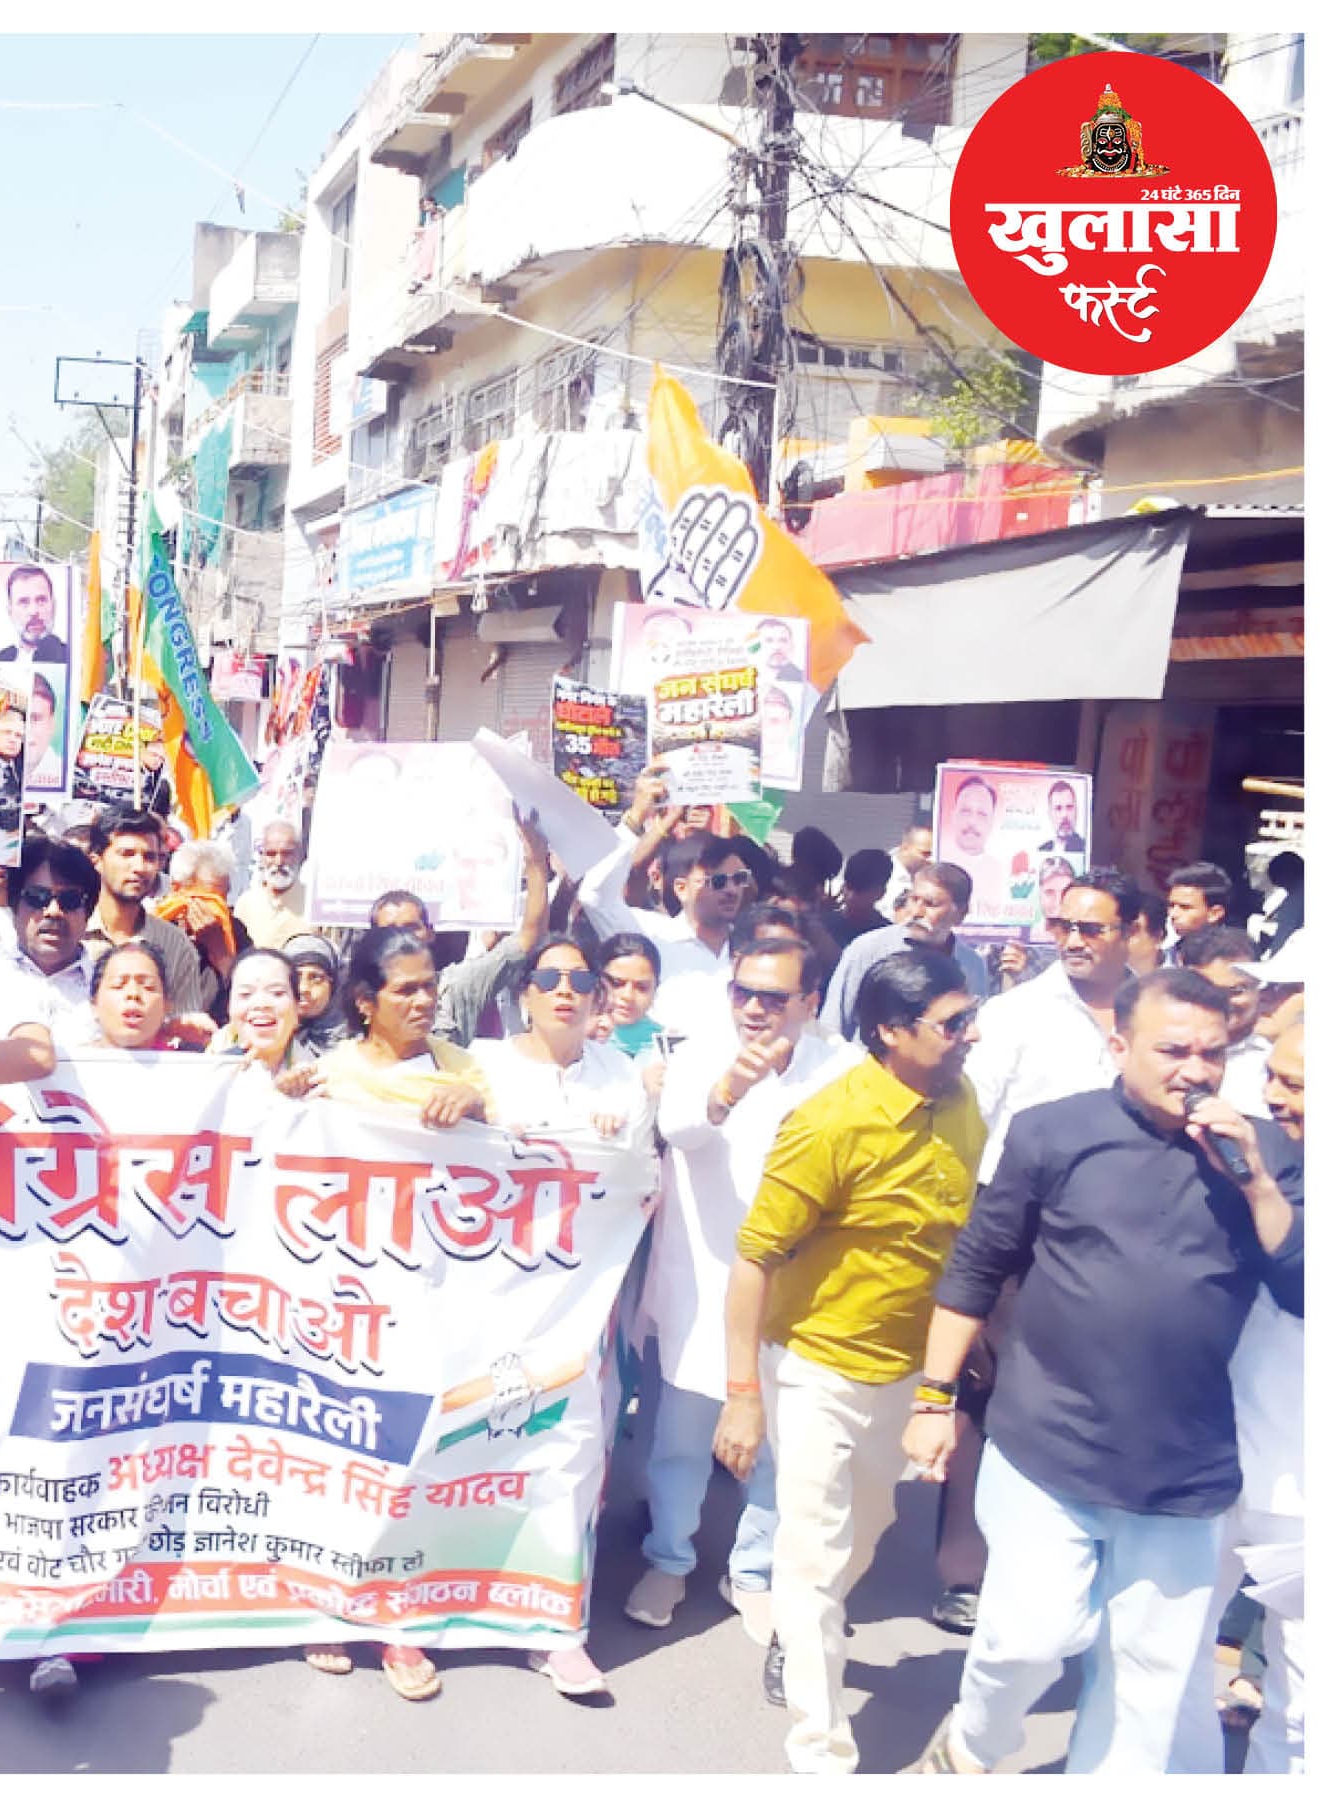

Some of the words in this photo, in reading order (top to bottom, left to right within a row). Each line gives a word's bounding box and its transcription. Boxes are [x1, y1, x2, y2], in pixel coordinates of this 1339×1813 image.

[660, 679, 697, 699] जन
[701, 667, 756, 696] संघर्ष
[565, 734, 590, 754] 35
[273, 1137, 604, 1268] लाओ
[50, 1360, 212, 1433] जनसंघर्ष
[219, 1370, 382, 1450] महारैली
[107, 1442, 214, 1492] अध्यक्ष
[225, 1435, 331, 1498] देवेन्द्र
[341, 1460, 414, 1519] सिंह
[424, 1470, 531, 1509] यादव
[3, 1512, 64, 1541] भाजपा
[69, 1508, 138, 1538] सरकार
[198, 1486, 272, 1518] विरोधी
[27, 1546, 62, 1580] वोट
[149, 1524, 186, 1558] छोड़
[193, 1525, 258, 1552] ज्ञानेश
[265, 1534, 325, 1567] कुमार
[168, 1567, 231, 1600] मोर्चा
[237, 1567, 279, 1599] एवं
